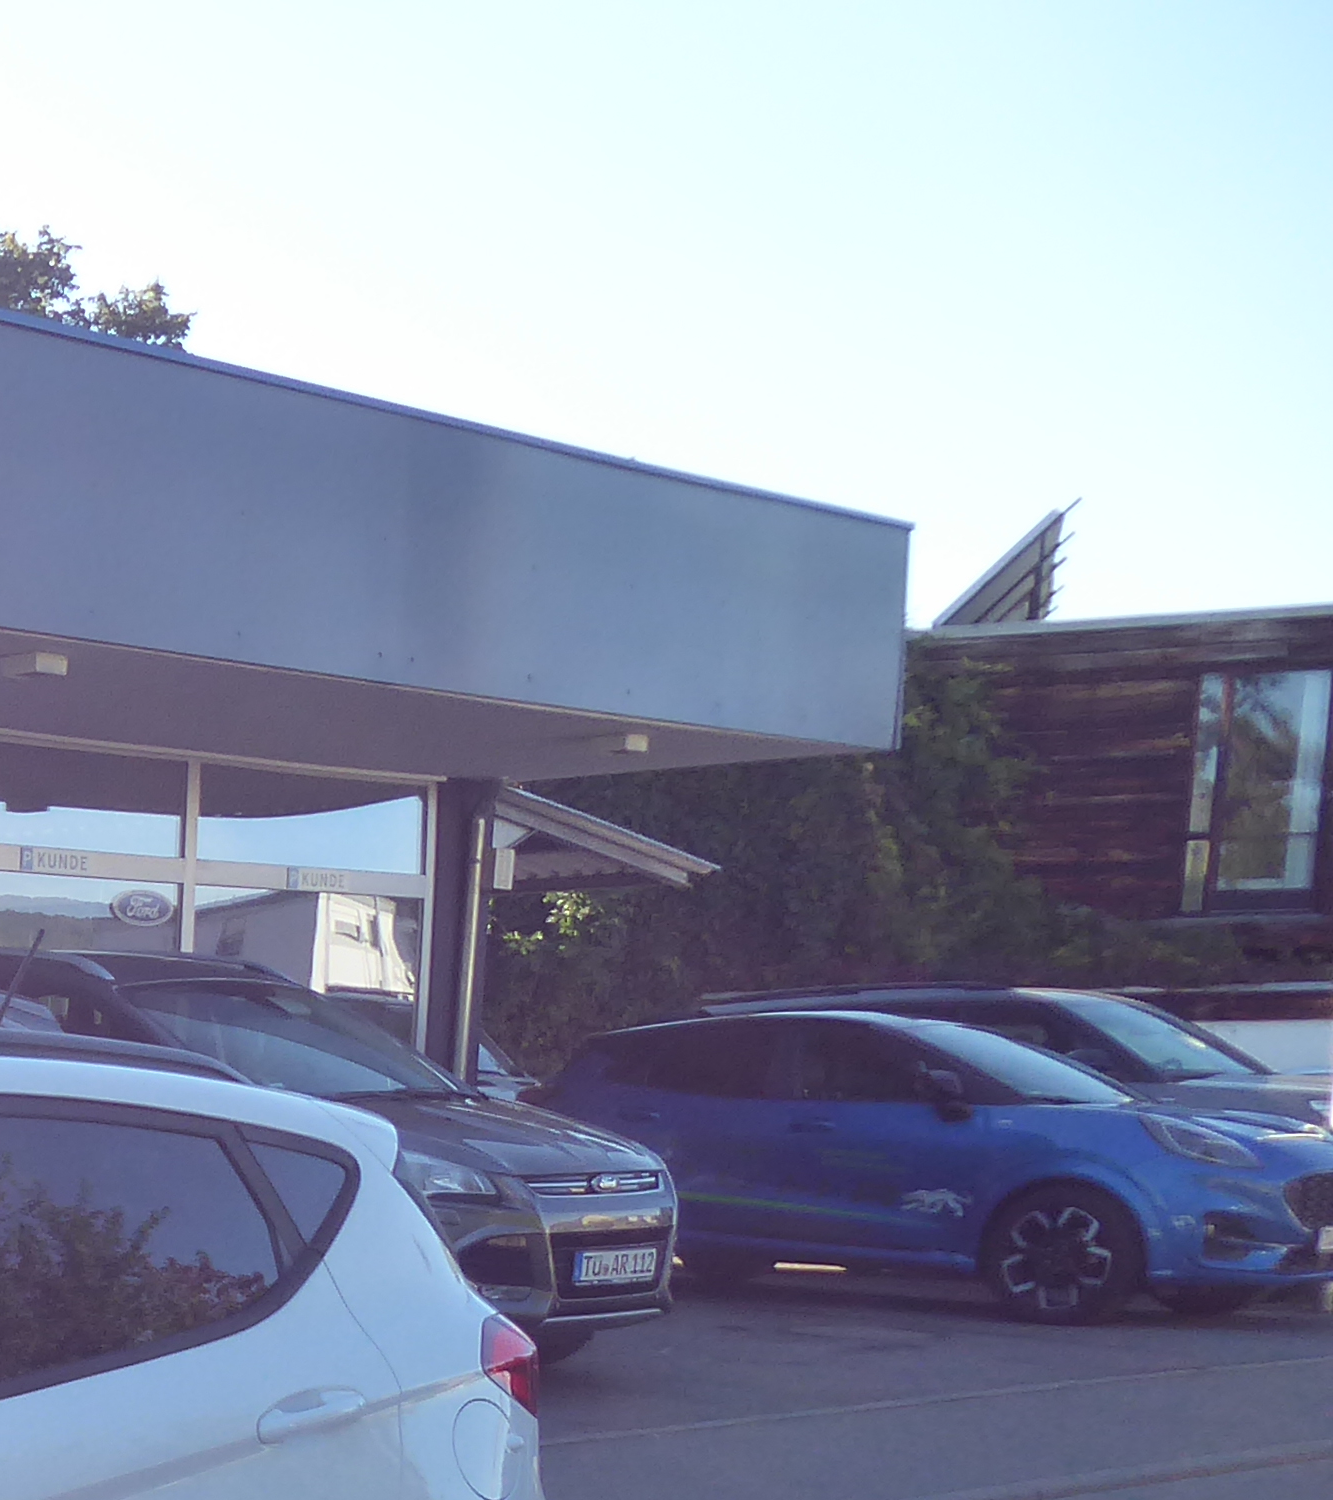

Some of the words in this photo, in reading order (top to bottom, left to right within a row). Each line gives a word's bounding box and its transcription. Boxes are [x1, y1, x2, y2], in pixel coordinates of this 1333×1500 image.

[36, 851, 88, 871] KUNDE
[301, 872, 345, 889] KUNDE
[610, 1253, 629, 1276] AR
[630, 1251, 655, 1274] 112
